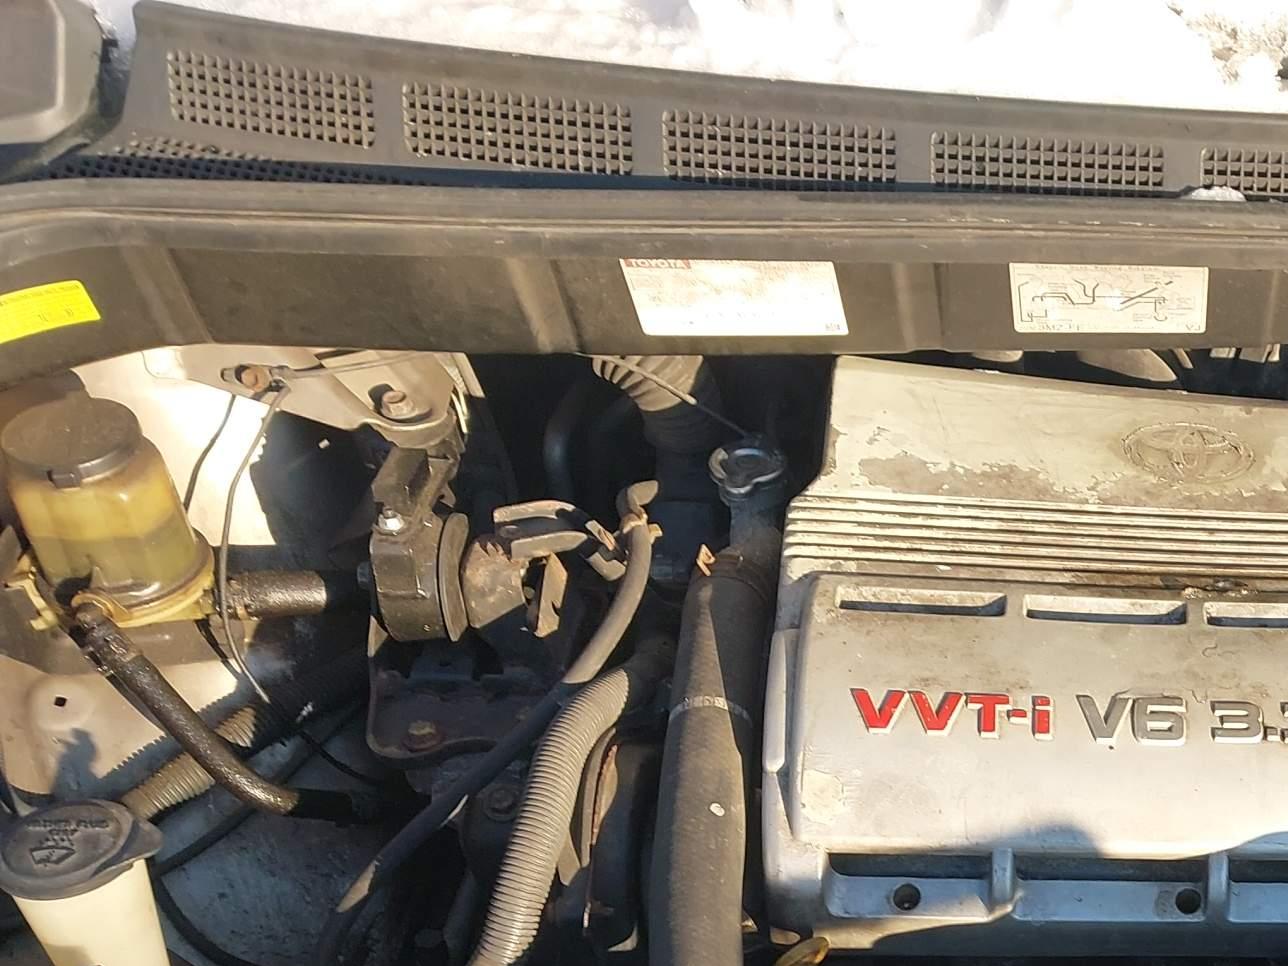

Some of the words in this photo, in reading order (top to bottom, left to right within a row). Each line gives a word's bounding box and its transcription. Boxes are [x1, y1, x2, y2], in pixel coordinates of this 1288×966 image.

[630, 258, 686, 269] TOYOTA
[850, 687, 1056, 741] VVT-i
[1075, 693, 1187, 747] V6
